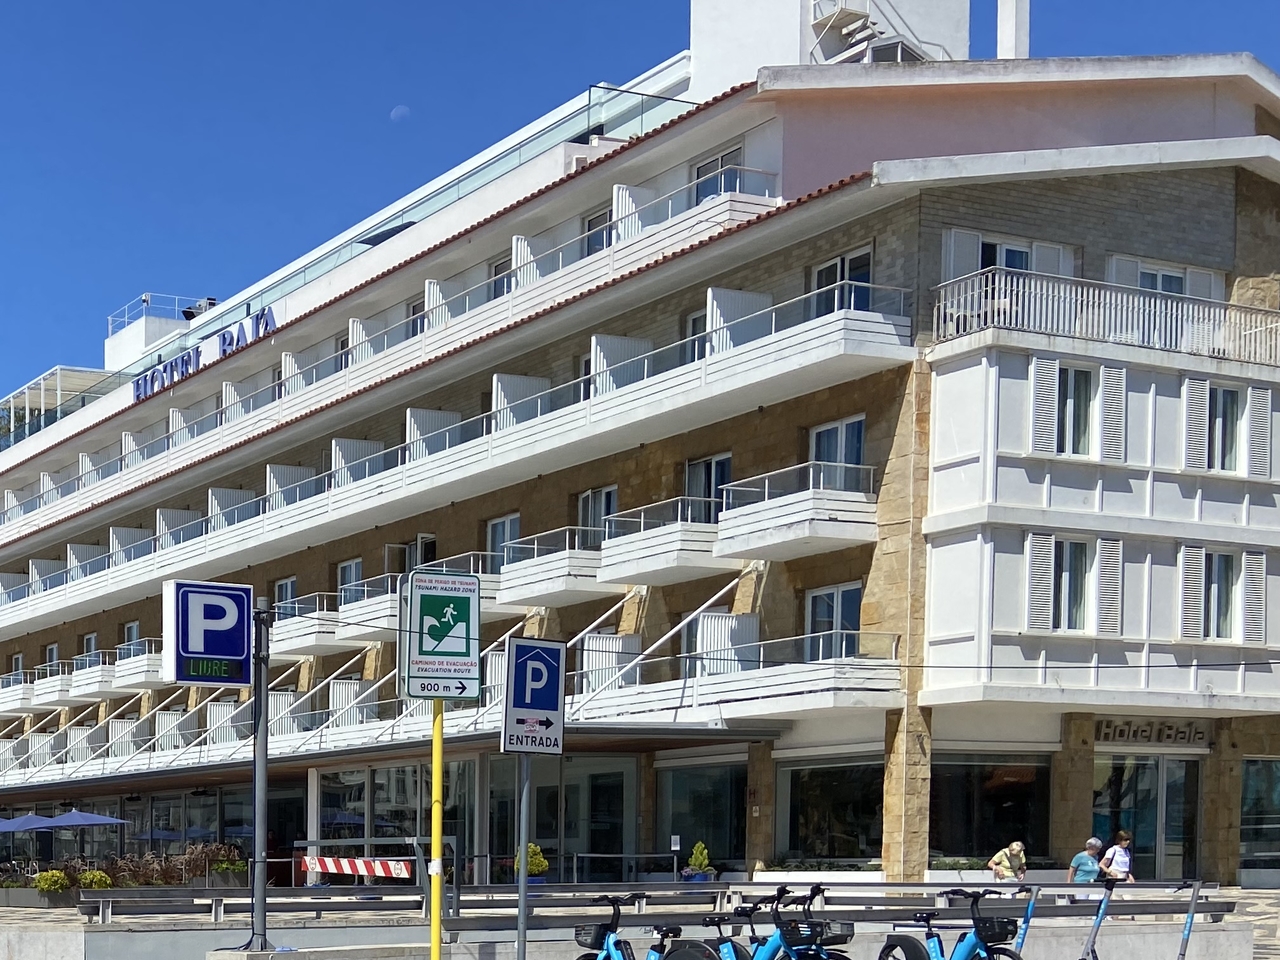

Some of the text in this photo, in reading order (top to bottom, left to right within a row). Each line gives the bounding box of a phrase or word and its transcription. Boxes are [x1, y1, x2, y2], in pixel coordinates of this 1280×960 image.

[132, 346, 201, 402] HOTEL
[188, 592, 239, 652] P
[446, 660, 477, 668] EVACUAÇÃO
[420, 683, 440, 692] 900
[524, 660, 548, 703] P
[509, 734, 560, 748] ENTRADA
[1095, 720, 1154, 743] Hotel
